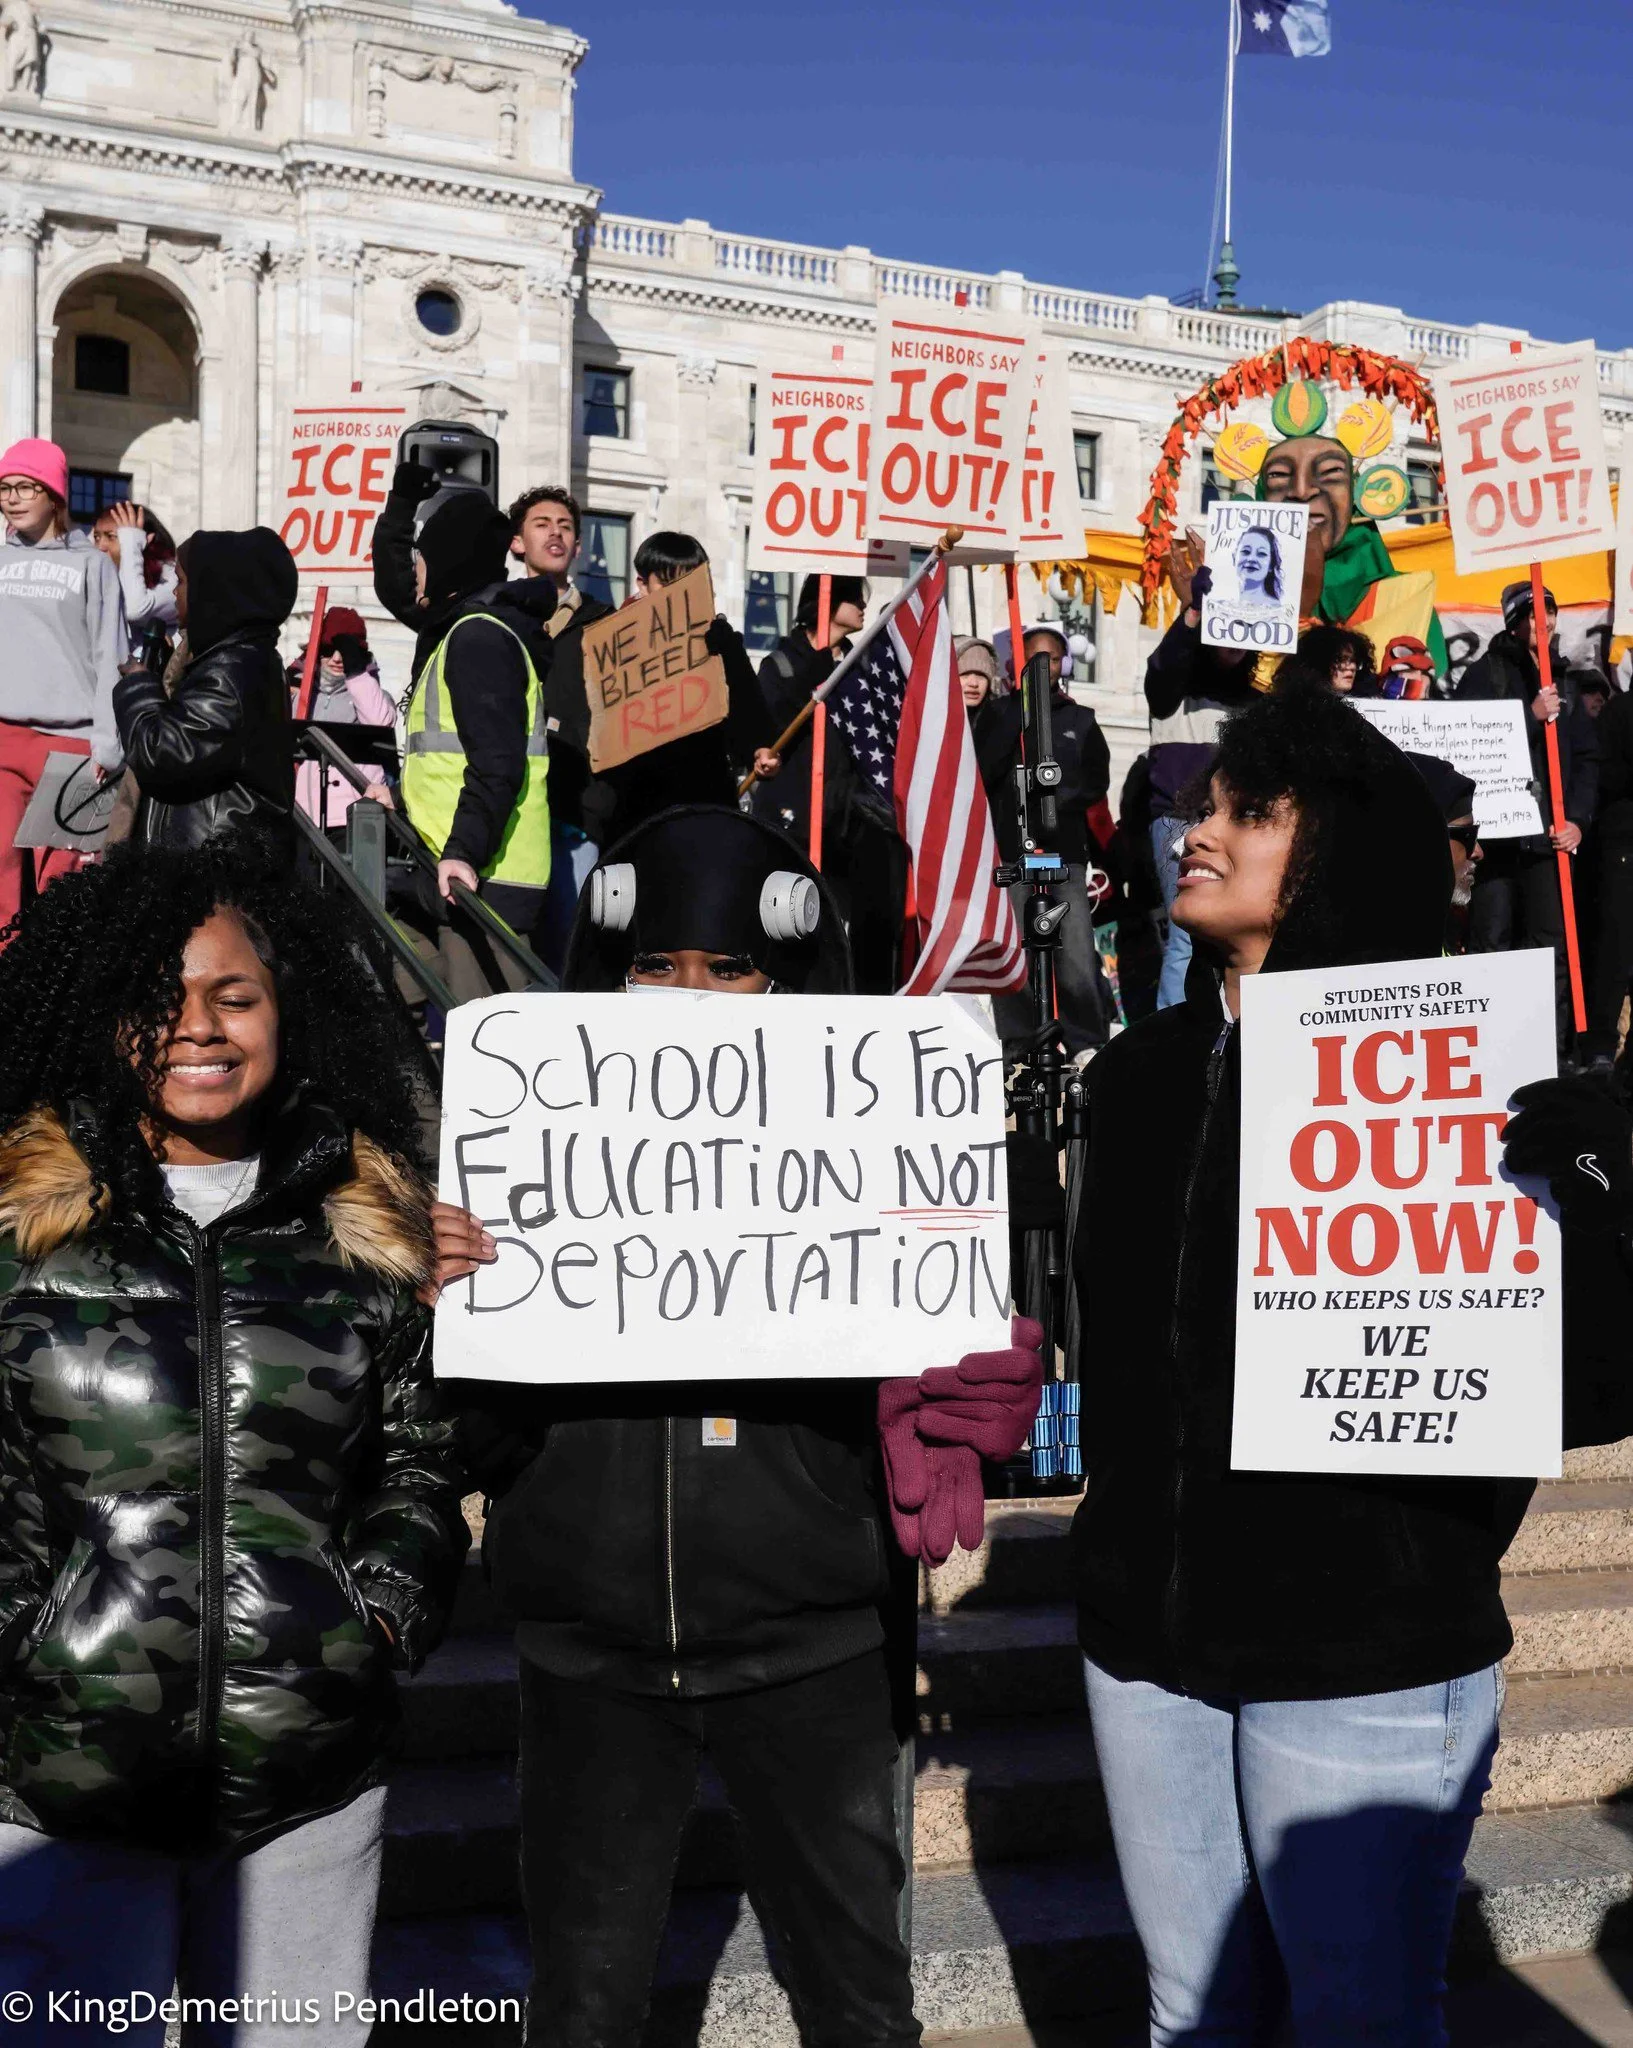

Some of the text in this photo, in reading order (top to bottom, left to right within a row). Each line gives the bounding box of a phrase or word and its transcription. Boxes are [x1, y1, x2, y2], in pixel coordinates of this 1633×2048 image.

[891, 340, 1020, 373] NEIGHBORS SAY
[772, 390, 865, 412] NEIGHBORS
[886, 368, 1008, 450] ICE
[1452, 374, 1581, 413] NEIGHBORS SAY
[293, 421, 402, 440] NEIGHBORS SAY
[1457, 400, 1581, 475] ICE
[287, 443, 392, 503] ICE
[881, 442, 1010, 522] OUT!
[1466, 467, 1593, 537] OUT!
[1210, 507, 1304, 540] JUSTICE
[1210, 530, 1237, 554] for
[0, 559, 83, 595] AKE GENEVA
[592, 589, 709, 676] WE ALL
[1206, 616, 1295, 647] GOOD
[600, 633, 711, 710] BLEED
[620, 675, 712, 749] RED
[1364, 709, 1514, 740] Terrible things are happening
[1413, 737, 1434, 749] Poor
[1435, 737, 1469, 751] helpless
[1454, 752, 1477, 761] their
[1486, 786, 1512, 798] parents
[1474, 819, 1498, 828] anuary
[1512, 810, 1533, 823] 1943
[1324, 981, 1464, 1006] STUDENTS FOR
[1299, 997, 1490, 1027] COMMUNITY SAFETY
[469, 1010, 767, 1127] School
[908, 1026, 1003, 1118] For
[1312, 1026, 1483, 1107] ICE
[1289, 1113, 1508, 1193] OUT
[894, 1140, 1007, 1207] NOT
[1253, 1197, 1540, 1277] NOW!
[1253, 1287, 1545, 1311] WHO KEEPS US SAFE?
[1362, 1325, 1431, 1357] WE
[1299, 1368, 1489, 1401] KEEP US
[1329, 1410, 1458, 1445] SAFE!
